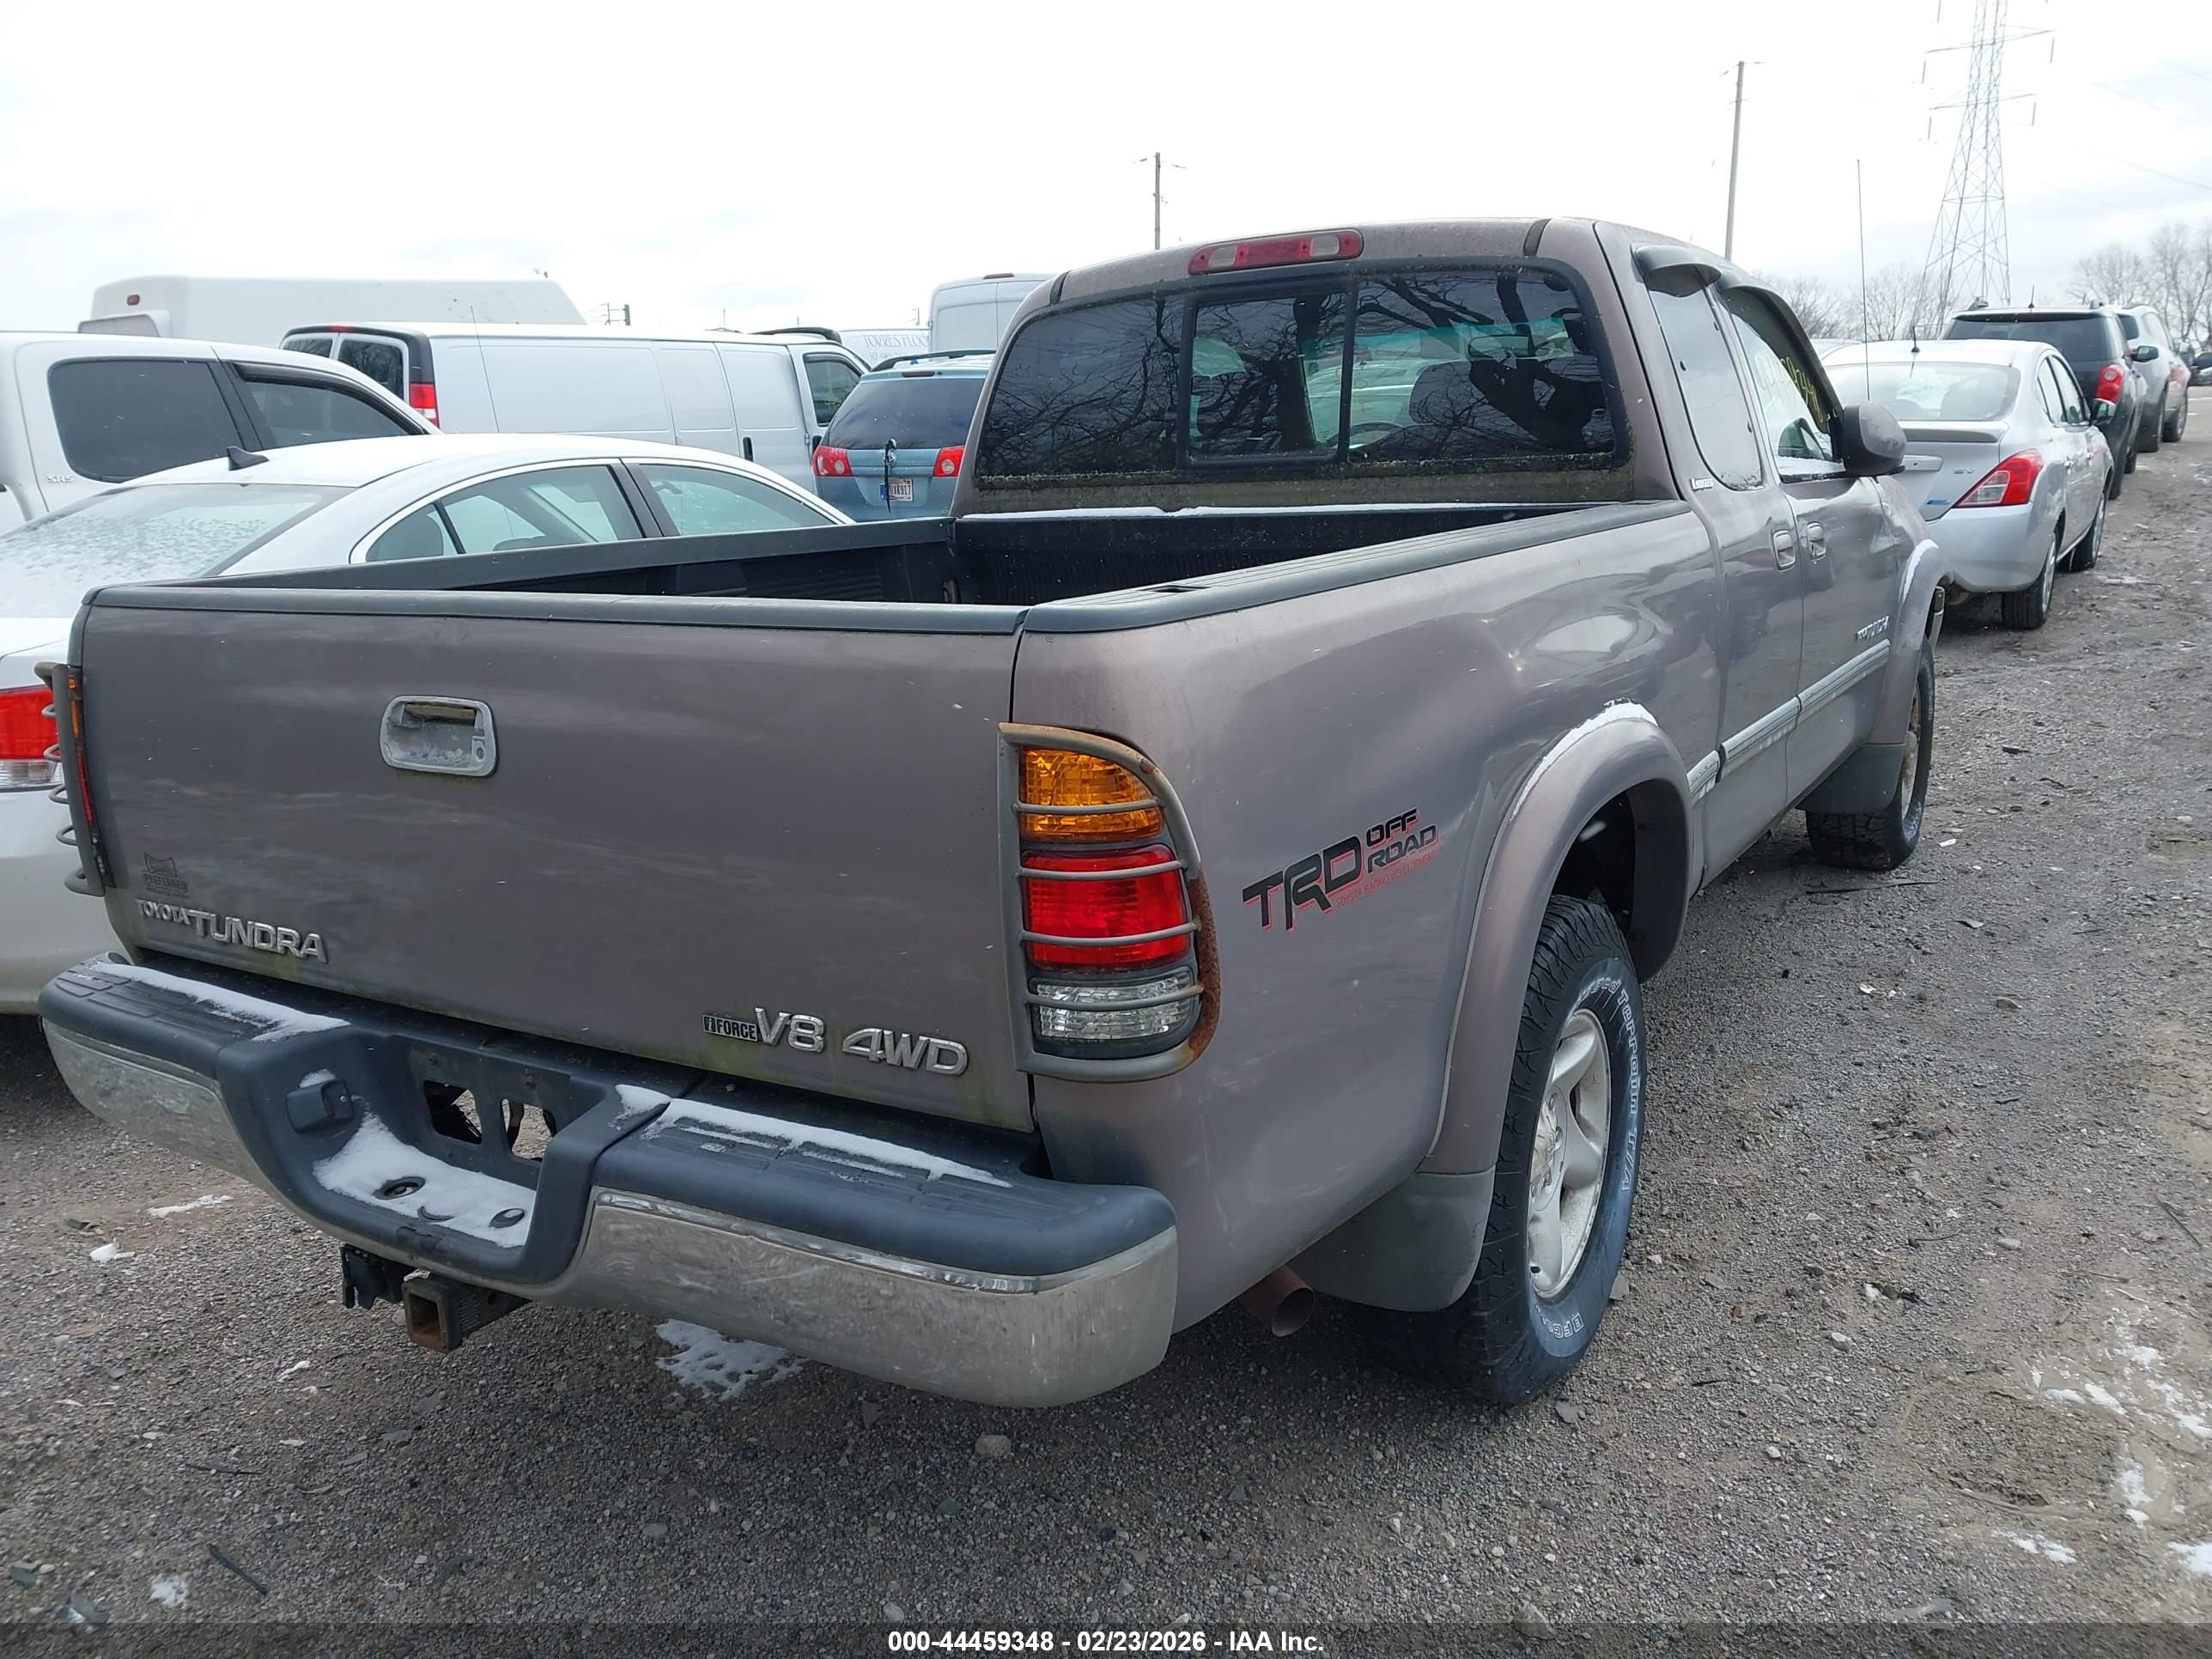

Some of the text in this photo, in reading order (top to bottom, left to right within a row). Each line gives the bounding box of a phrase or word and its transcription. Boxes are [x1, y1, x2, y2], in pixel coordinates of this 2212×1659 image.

[1366, 808, 1419, 848] OFF
[1242, 824, 1439, 931] TRD ROAD
[136, 899, 329, 963] TOYOTA TUNDRA
[754, 1006, 826, 1054] V8
[842, 1026, 969, 1077] 4WD
